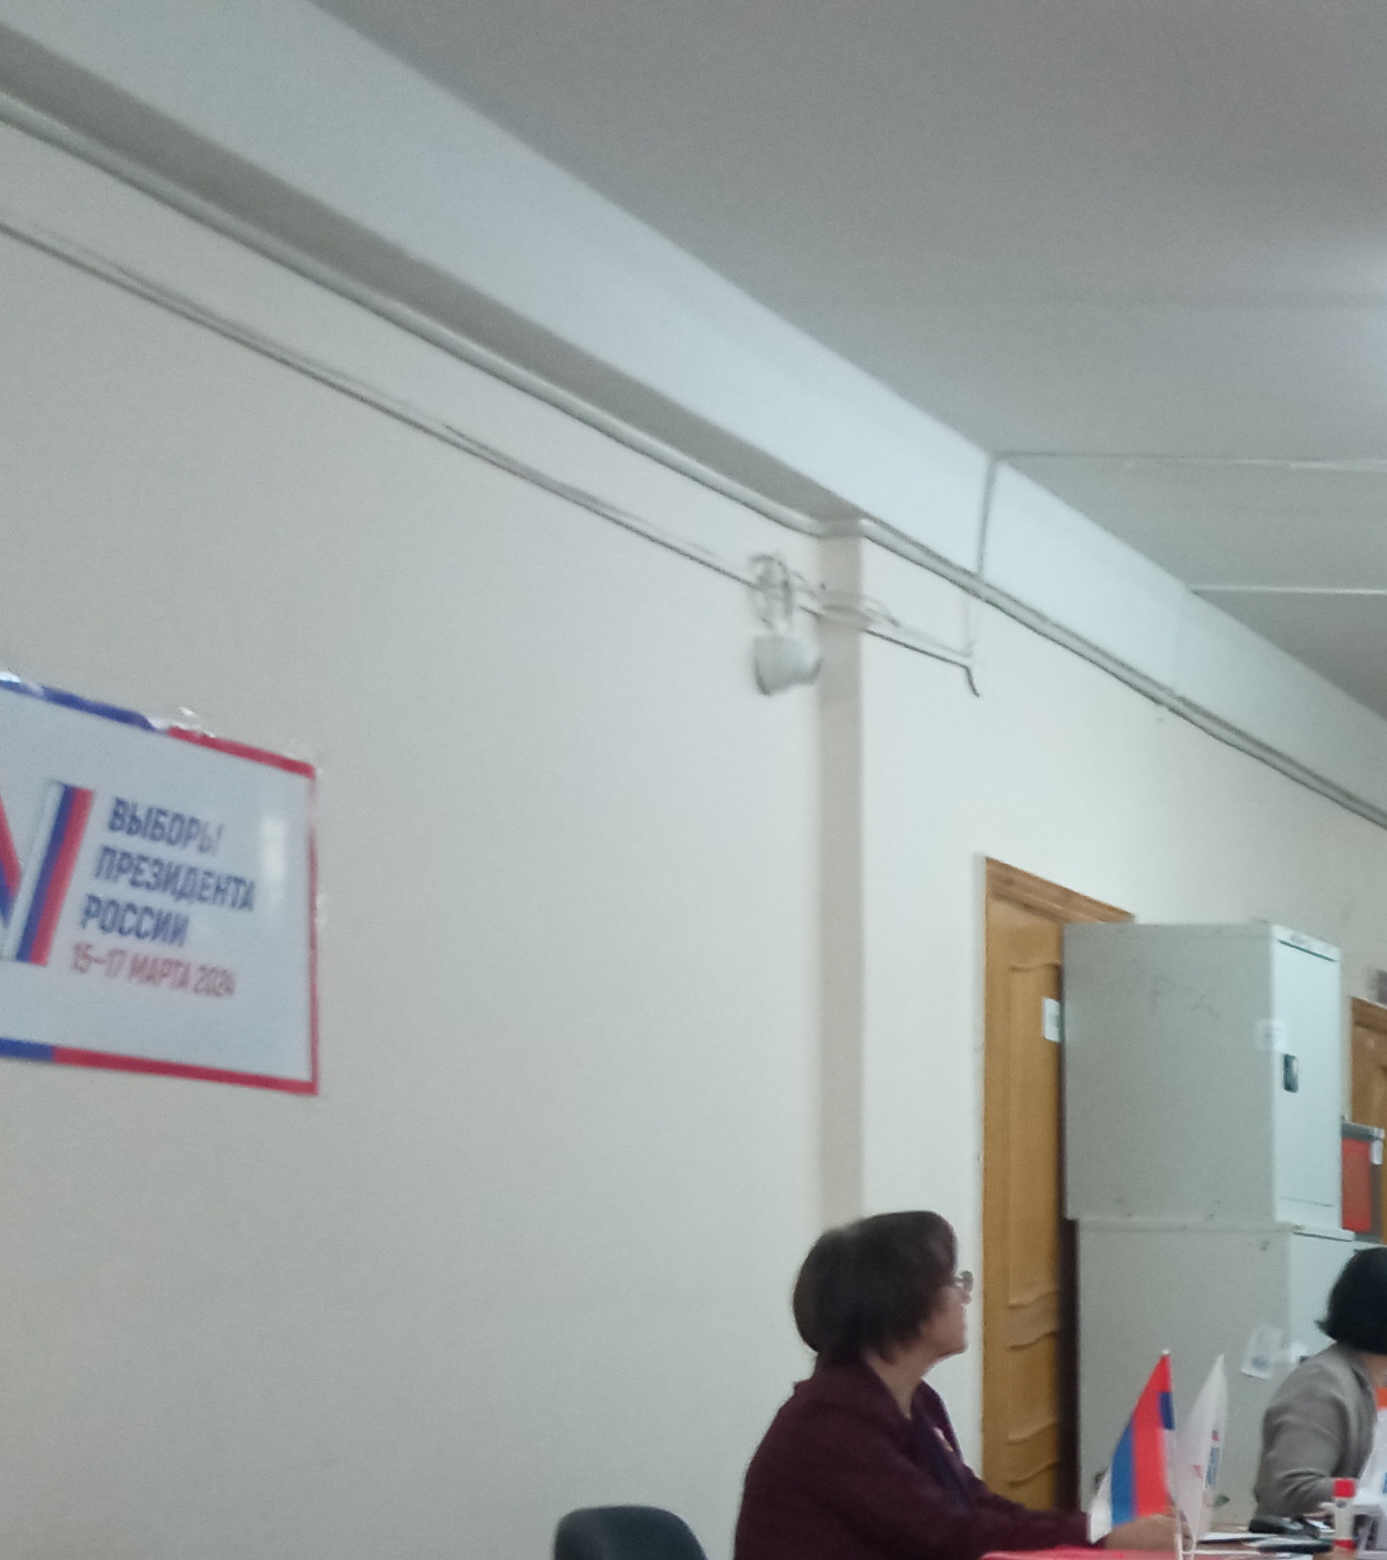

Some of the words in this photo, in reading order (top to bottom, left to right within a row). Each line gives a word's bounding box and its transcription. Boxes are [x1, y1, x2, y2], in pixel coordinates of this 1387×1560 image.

[107, 796, 226, 856] ВЫБОРЫ
[94, 844, 256, 912] ПРЕЗИДЕНТА
[80, 893, 191, 947] РОССИИ
[128, 952, 192, 991] МАРТА
